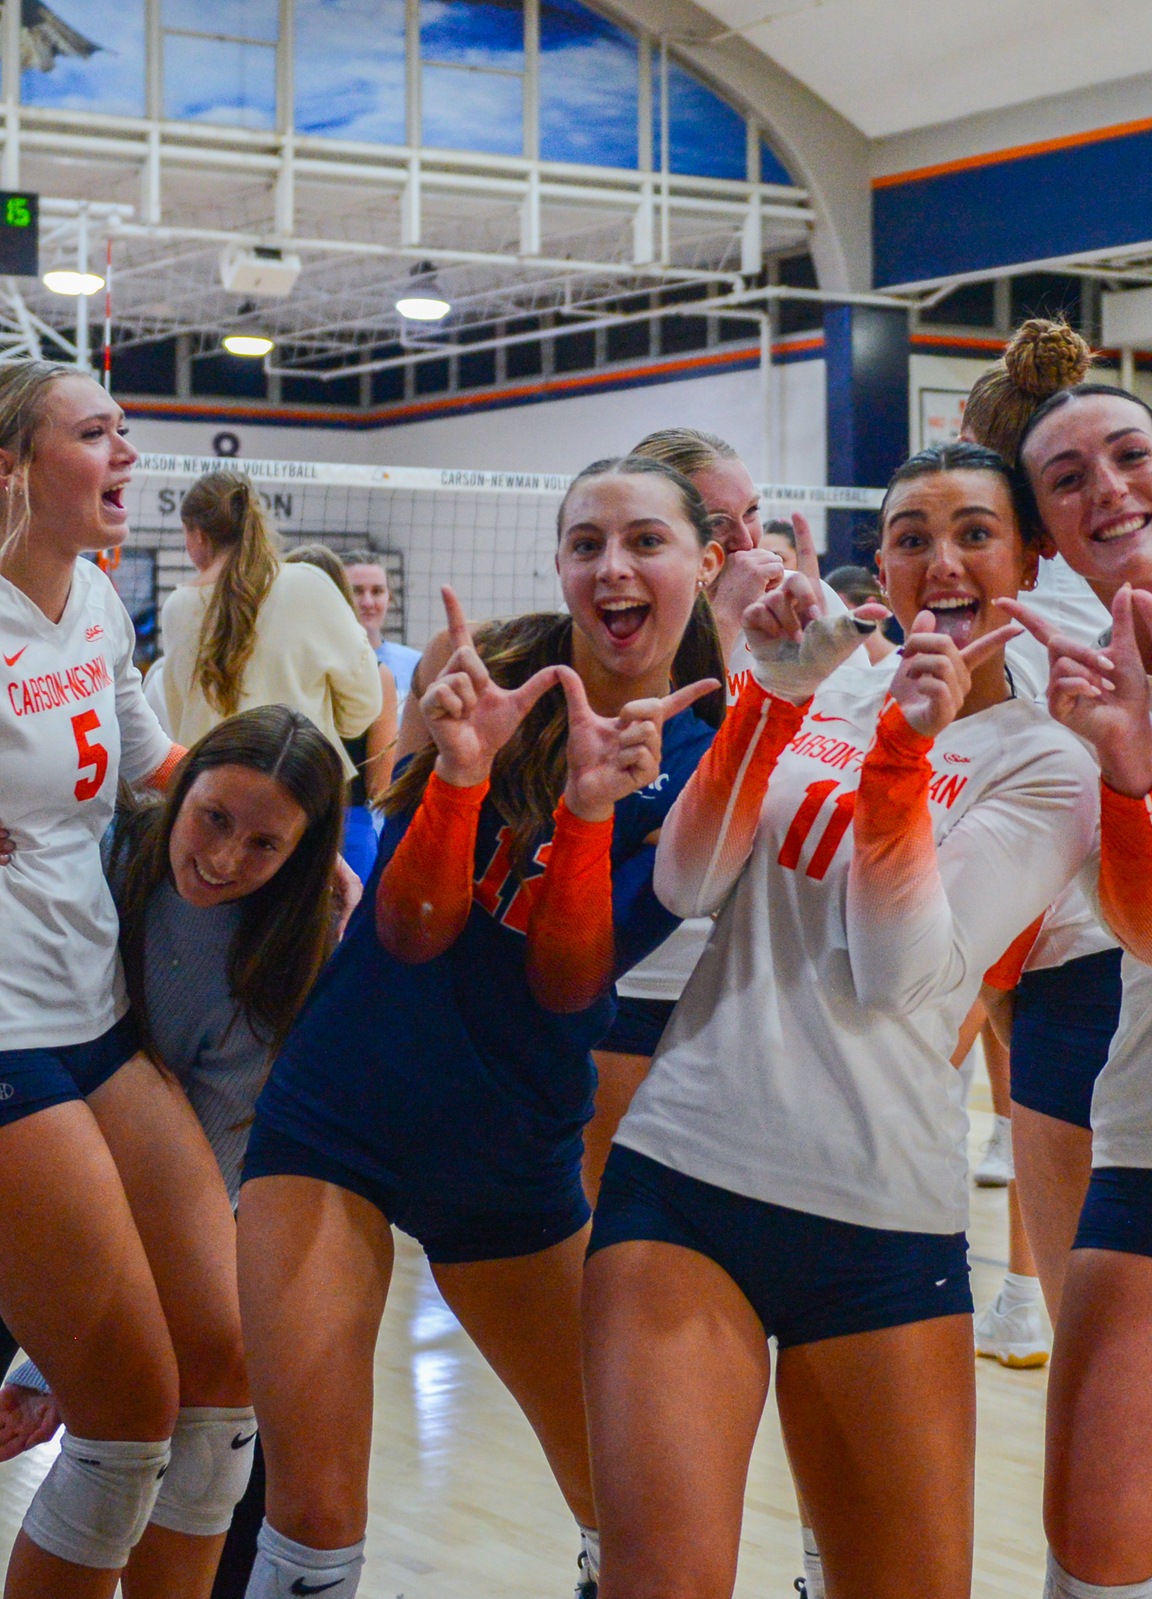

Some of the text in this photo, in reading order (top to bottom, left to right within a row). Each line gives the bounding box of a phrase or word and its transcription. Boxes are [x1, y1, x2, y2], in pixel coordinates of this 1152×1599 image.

[134, 454, 318, 478] ARSON-NEWMAN VOLLEYBALL
[440, 469, 540, 489] CARSON-NEWMAN
[71, 708, 108, 802] 5
[777, 778, 858, 882] 11
